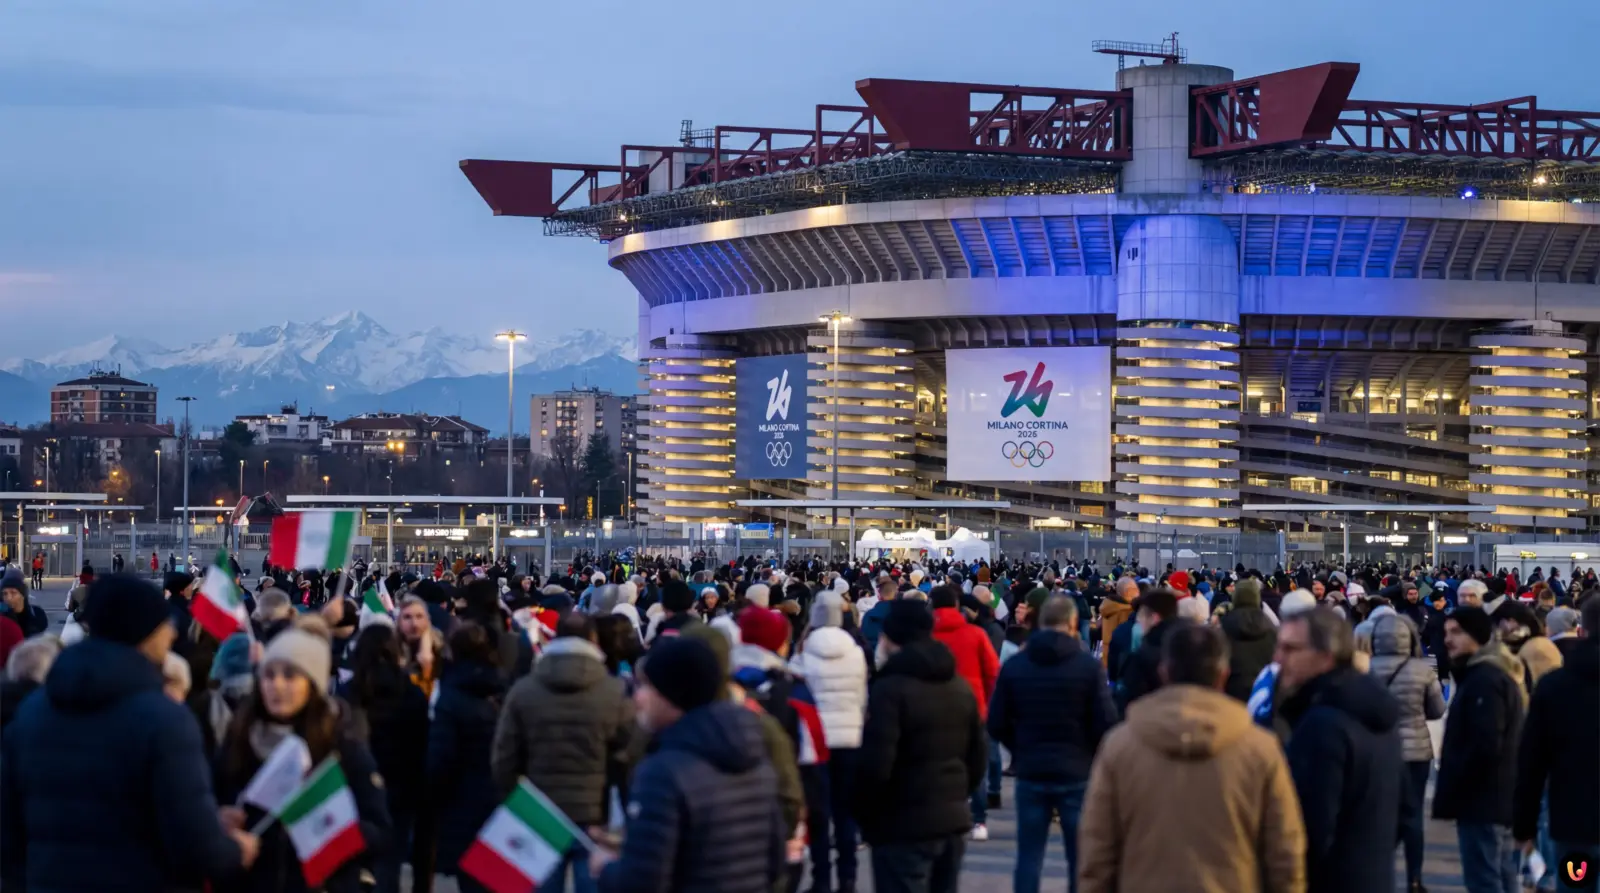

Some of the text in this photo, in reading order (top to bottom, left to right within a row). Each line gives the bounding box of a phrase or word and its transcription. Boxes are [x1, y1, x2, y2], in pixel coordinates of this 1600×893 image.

[758, 424, 778, 432] MILANO
[987, 421, 1069, 430] MILANO CORTINA
[1017, 430, 1038, 438] 2026
